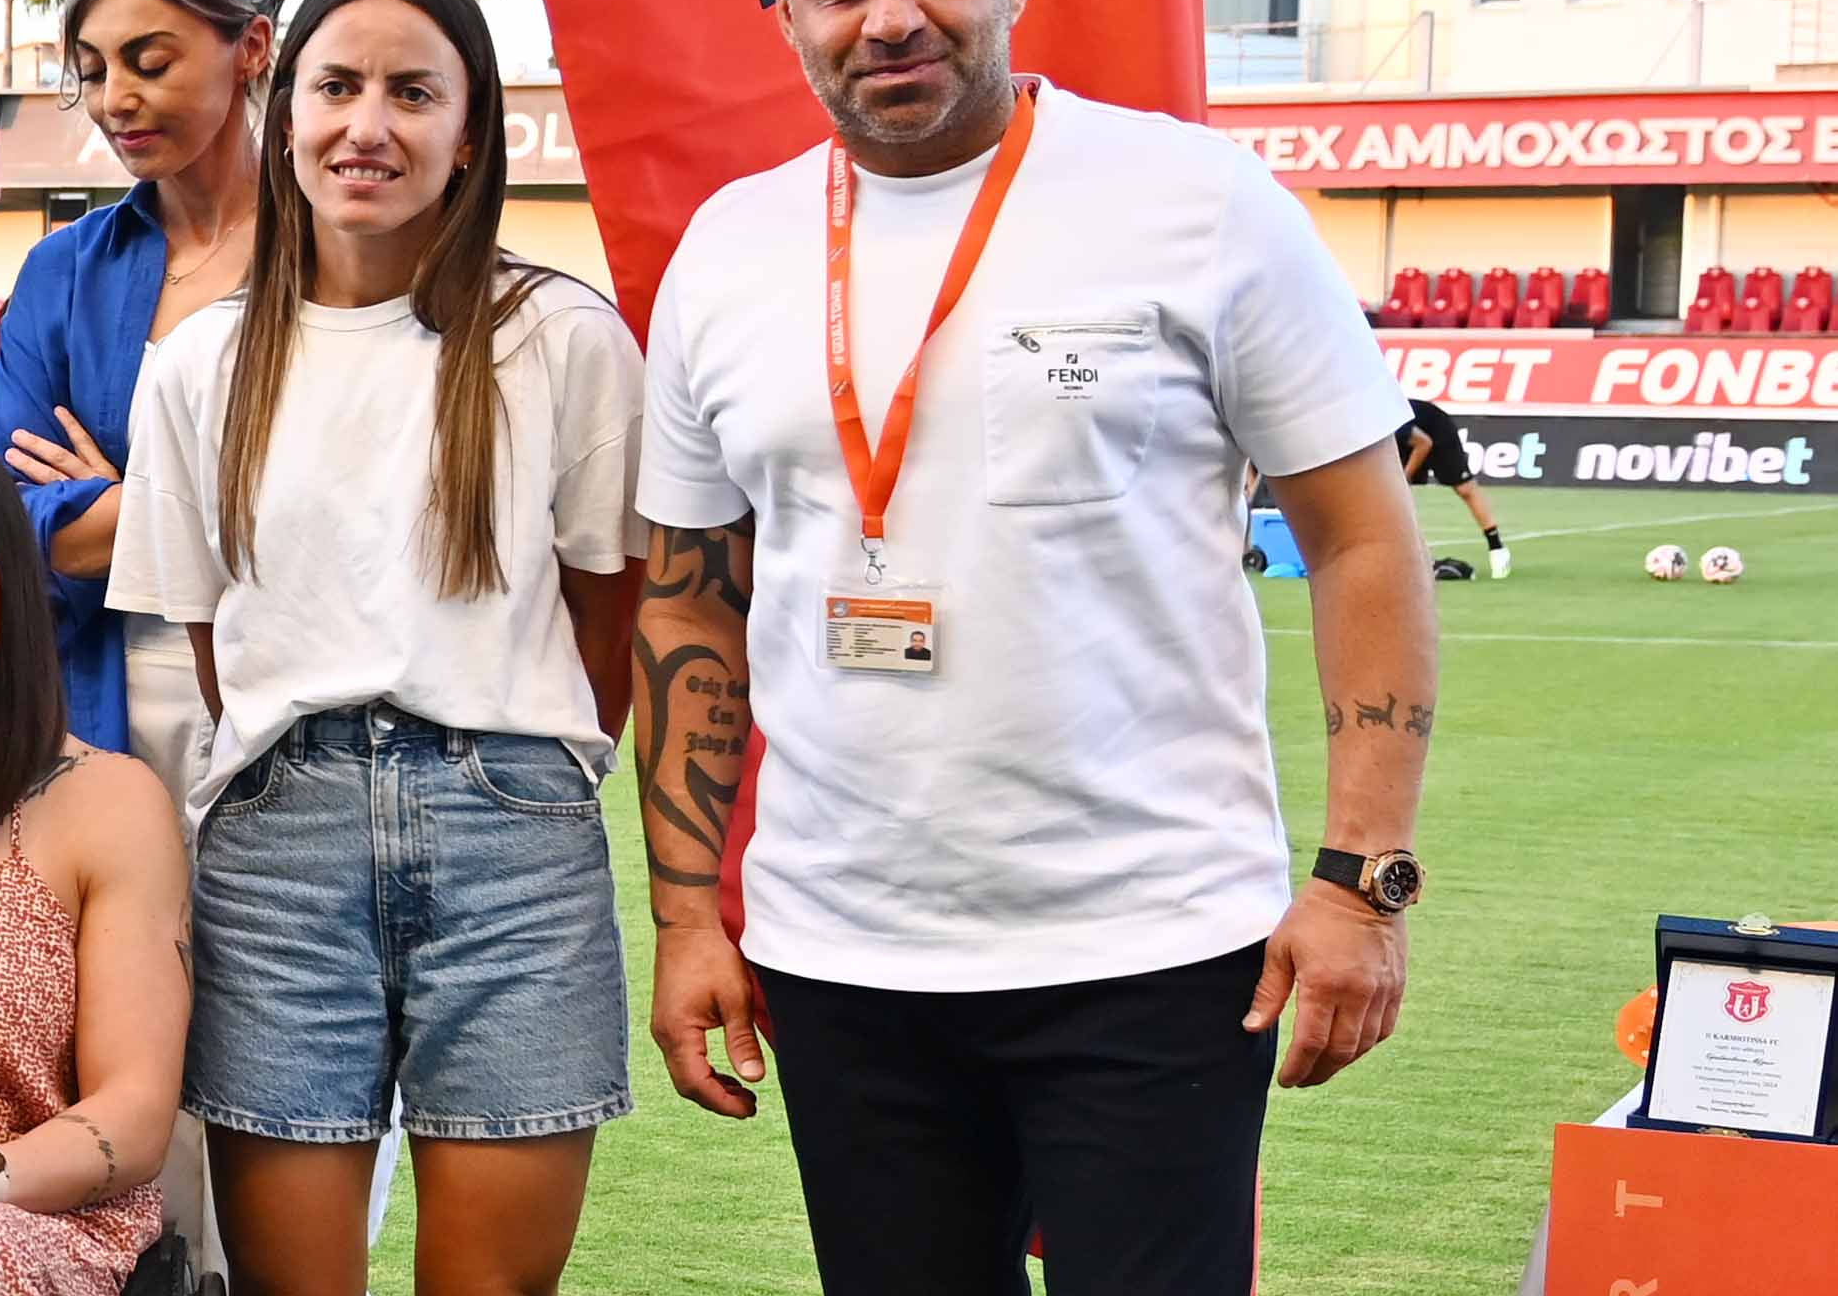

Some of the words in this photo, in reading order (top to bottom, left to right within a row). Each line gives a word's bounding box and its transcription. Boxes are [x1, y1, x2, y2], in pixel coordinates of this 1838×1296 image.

[1347, 115, 1806, 171] ΑΜΜΟΧΩΣΤΟΣ
[1048, 368, 1098, 383] FENDI
[1574, 432, 1813, 485] novibet
